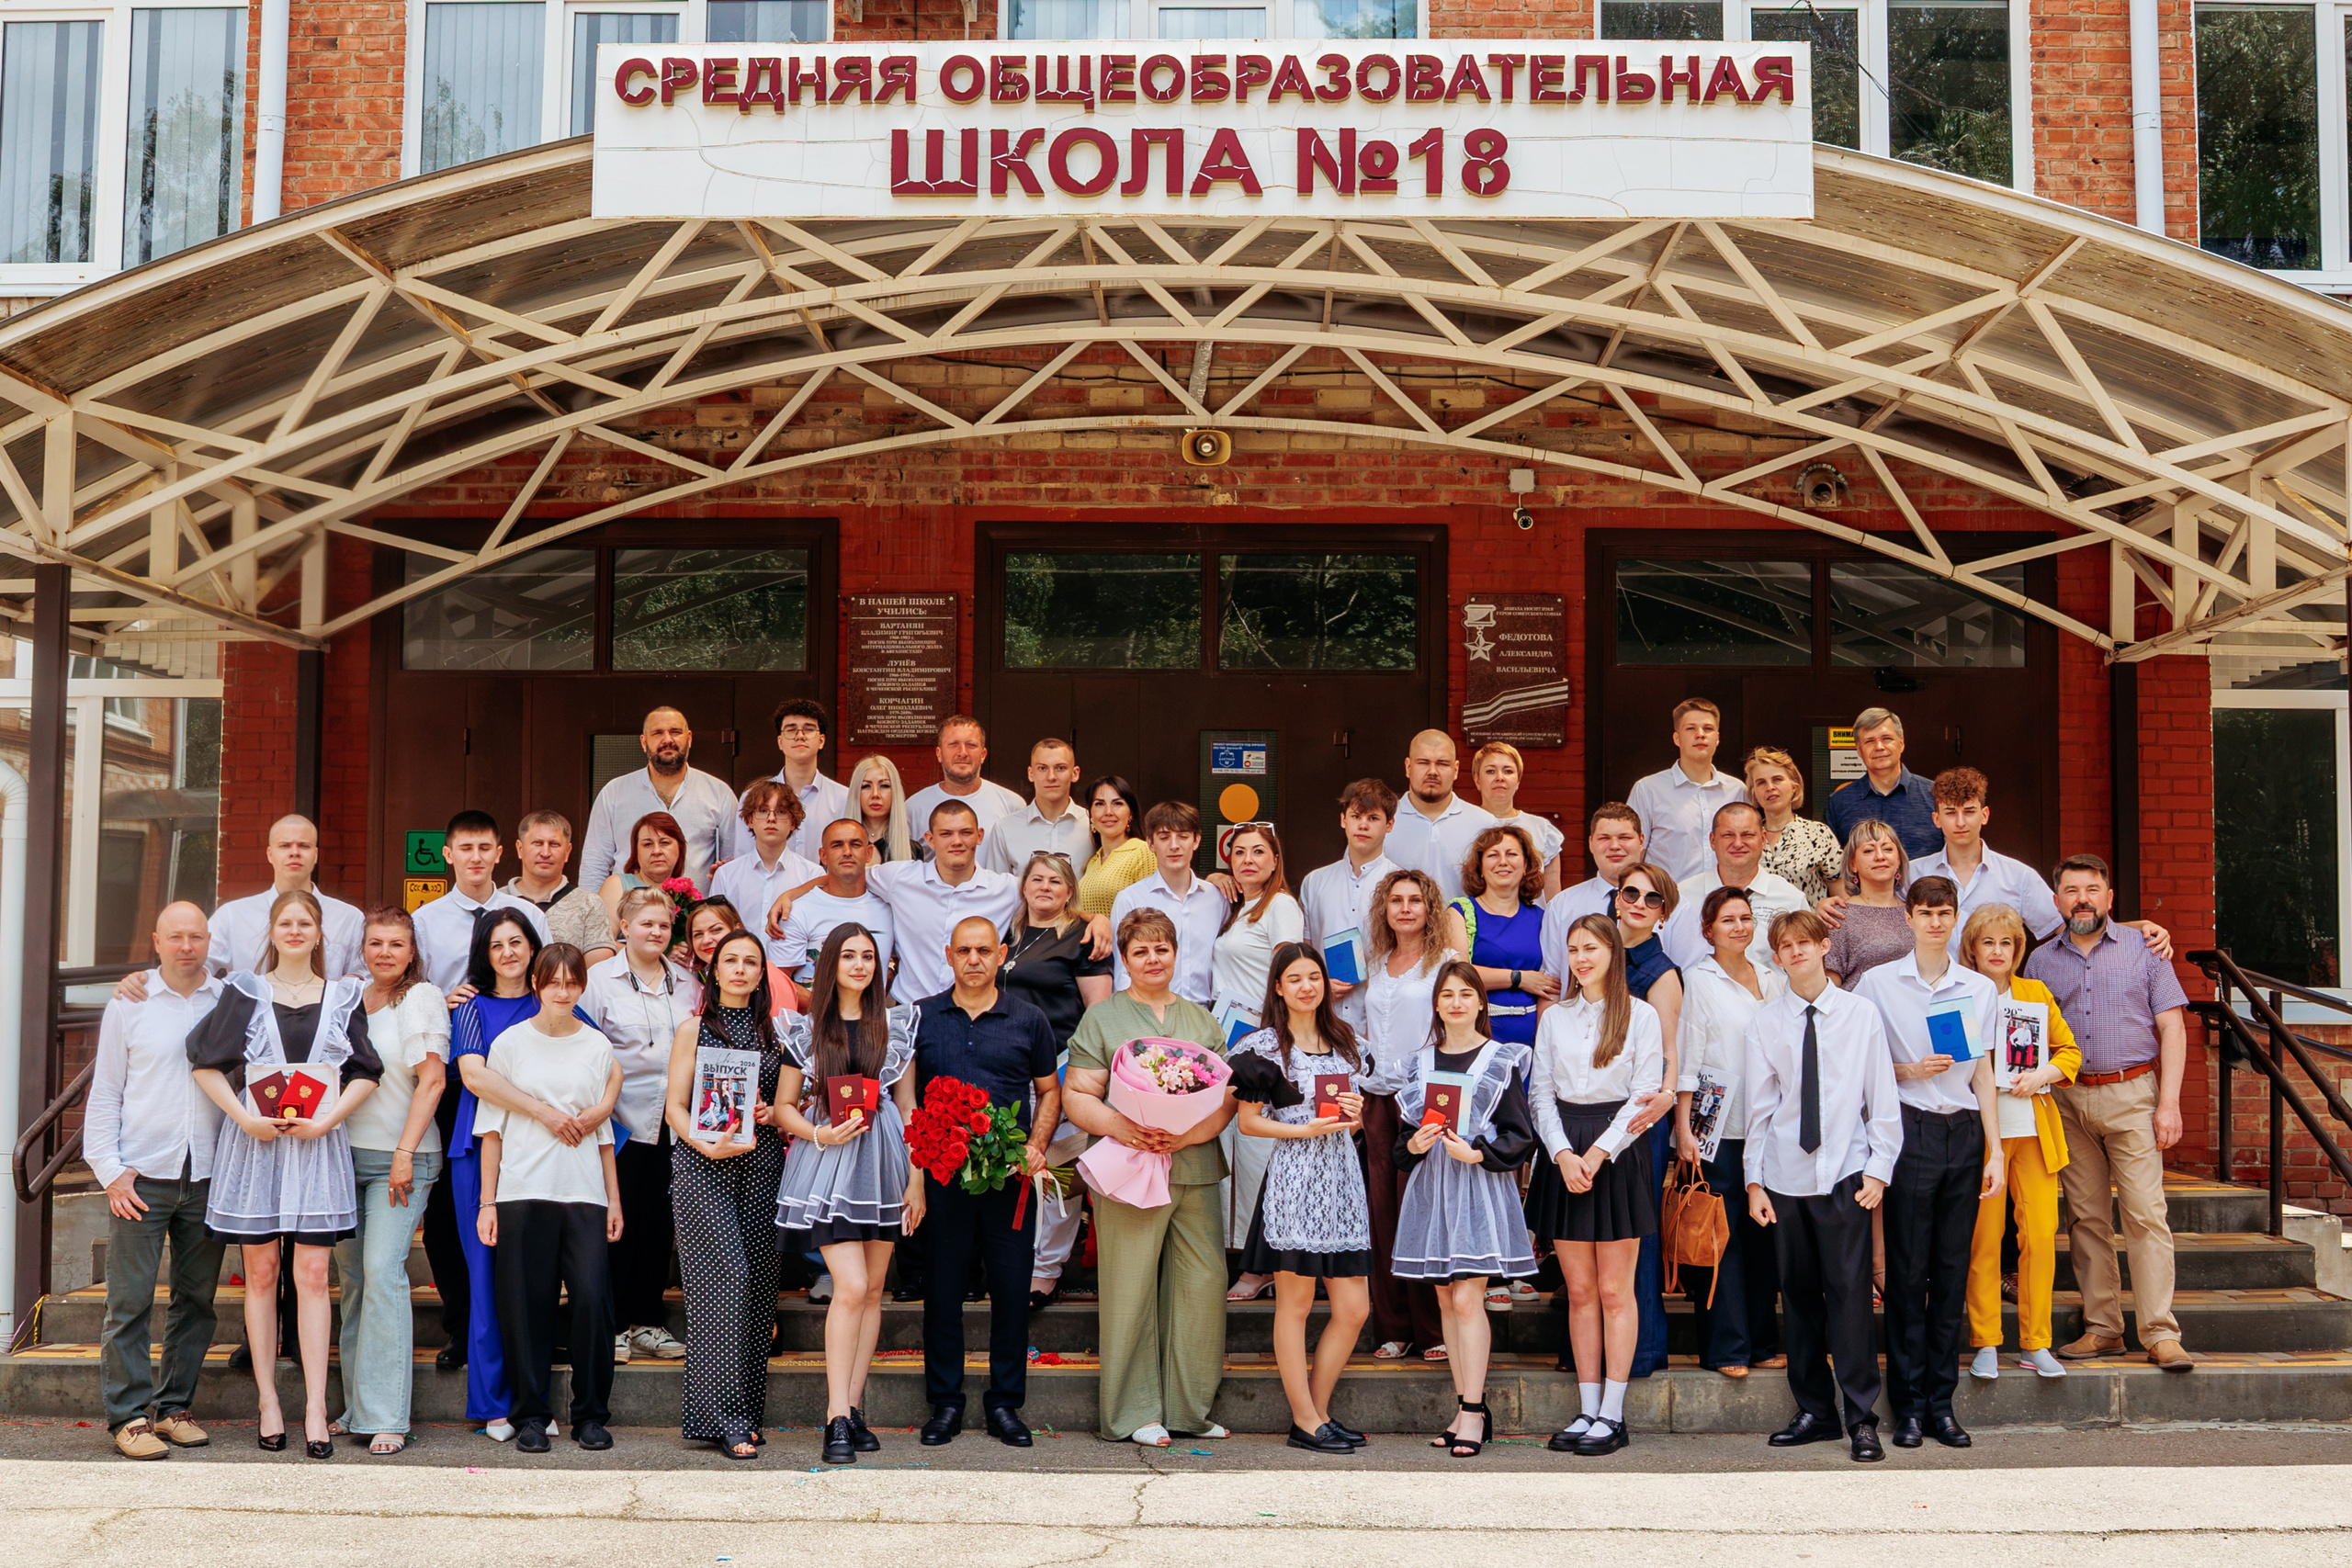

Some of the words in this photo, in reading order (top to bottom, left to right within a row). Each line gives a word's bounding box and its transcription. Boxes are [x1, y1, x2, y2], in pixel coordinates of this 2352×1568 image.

[615, 56, 917, 111] СРЕДНЯЯ
[939, 54, 1794, 109] ОБЩЕОБРАЗОВАТЕЛЬНАЯ
[890, 127, 1264, 197] ШКОЛА
[1297, 127, 1510, 197] №18
[868, 596, 907, 605] НАШЕЙ
[1498, 633, 1554, 642] ФЕДОТОВА
[703, 1063, 748, 1076] ВЫПУСК
